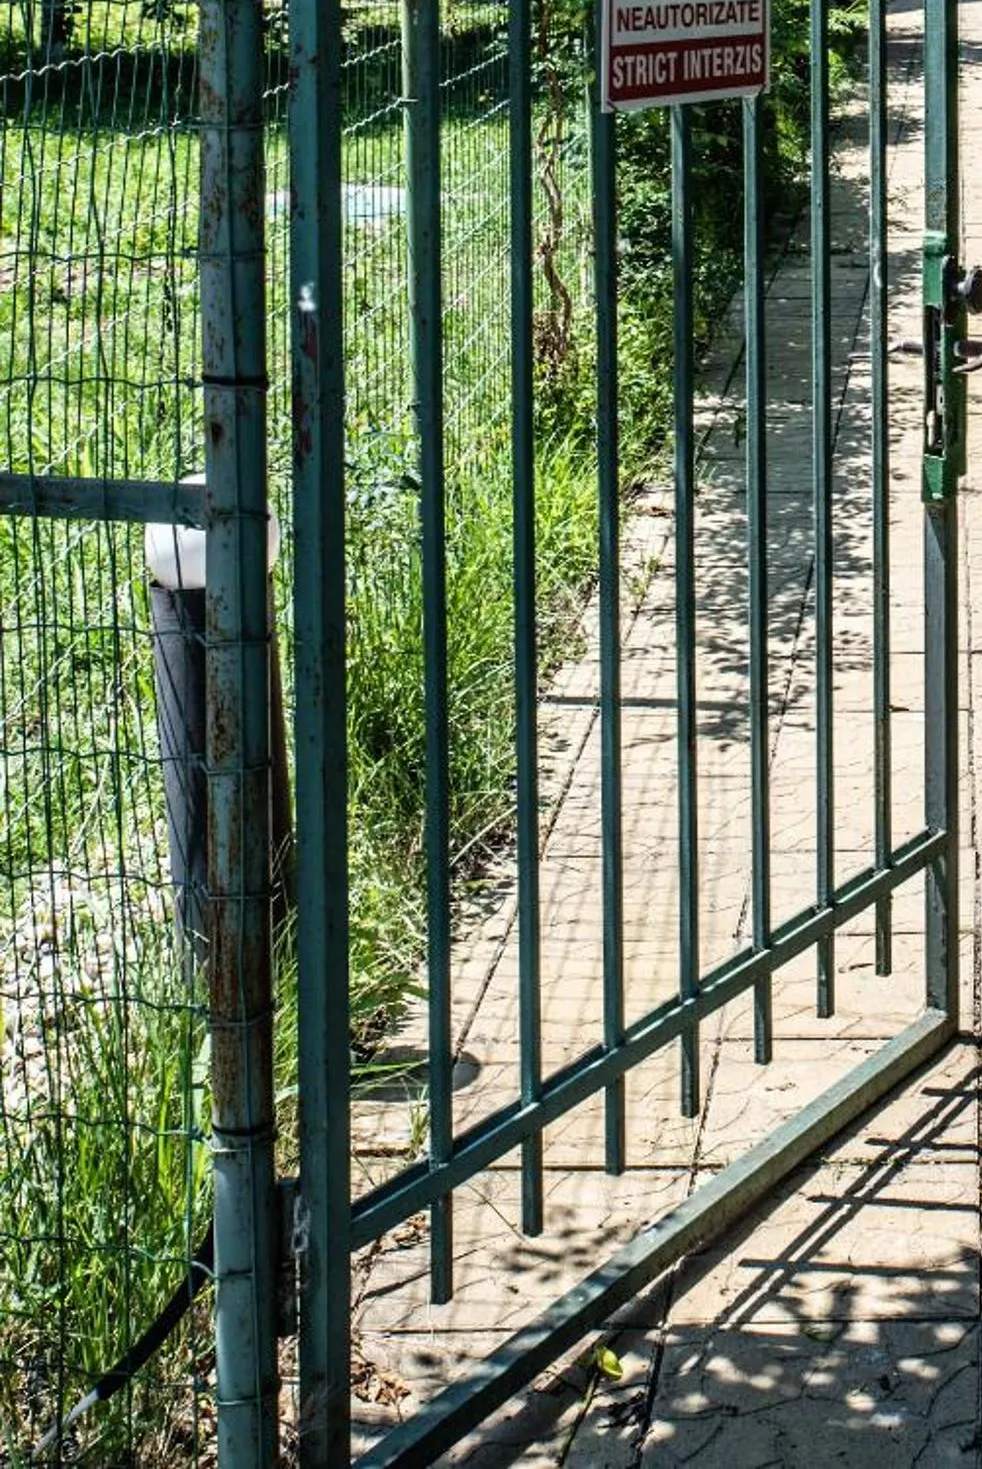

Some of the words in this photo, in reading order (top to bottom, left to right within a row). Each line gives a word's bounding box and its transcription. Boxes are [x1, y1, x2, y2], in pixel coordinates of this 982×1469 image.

[616, 0, 760, 32] NEAUTORIZATE
[612, 51, 678, 90] STRICT
[683, 43, 763, 81] INTERZIS
